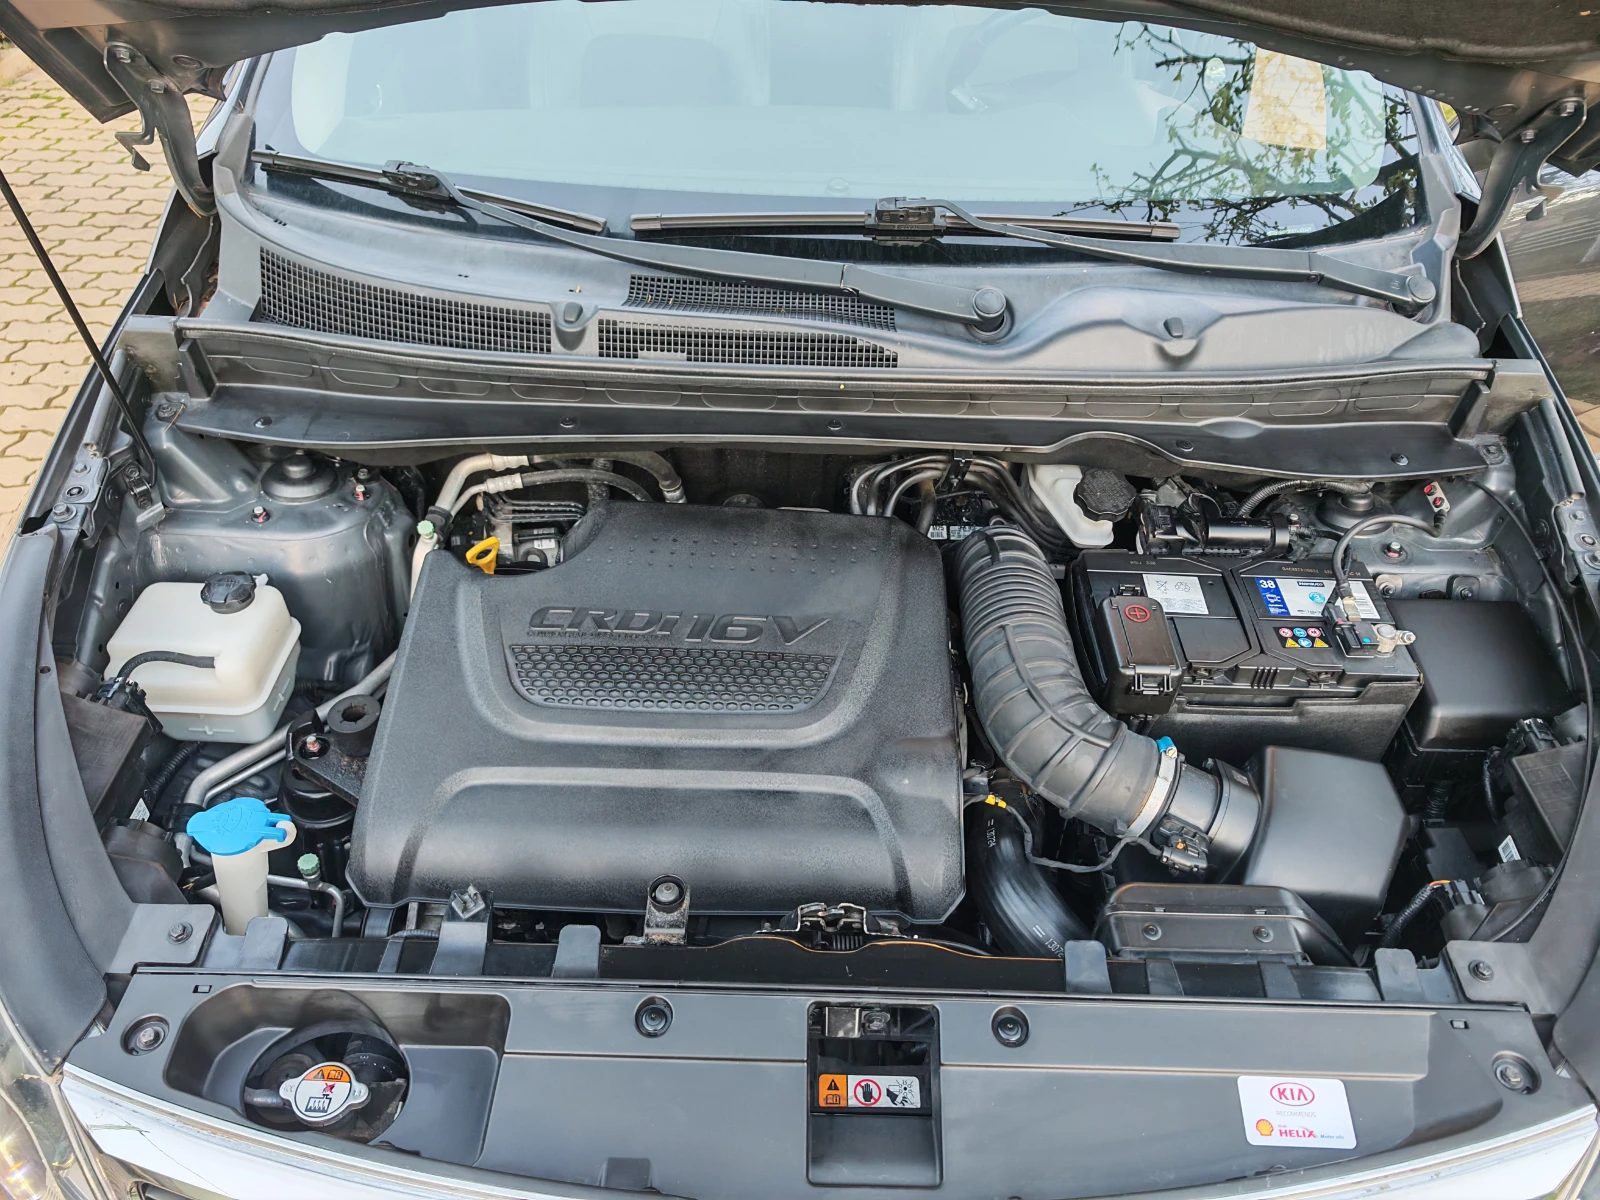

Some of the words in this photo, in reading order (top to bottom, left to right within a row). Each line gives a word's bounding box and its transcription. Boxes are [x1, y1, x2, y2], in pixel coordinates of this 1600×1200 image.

[1259, 579, 1276, 589] 38
[685, 613, 832, 645] 16V
[1277, 1087, 1309, 1101] KIA
[1276, 1110, 1317, 1118] RECOMMENDS
[1279, 1129, 1317, 1138] HELIX
